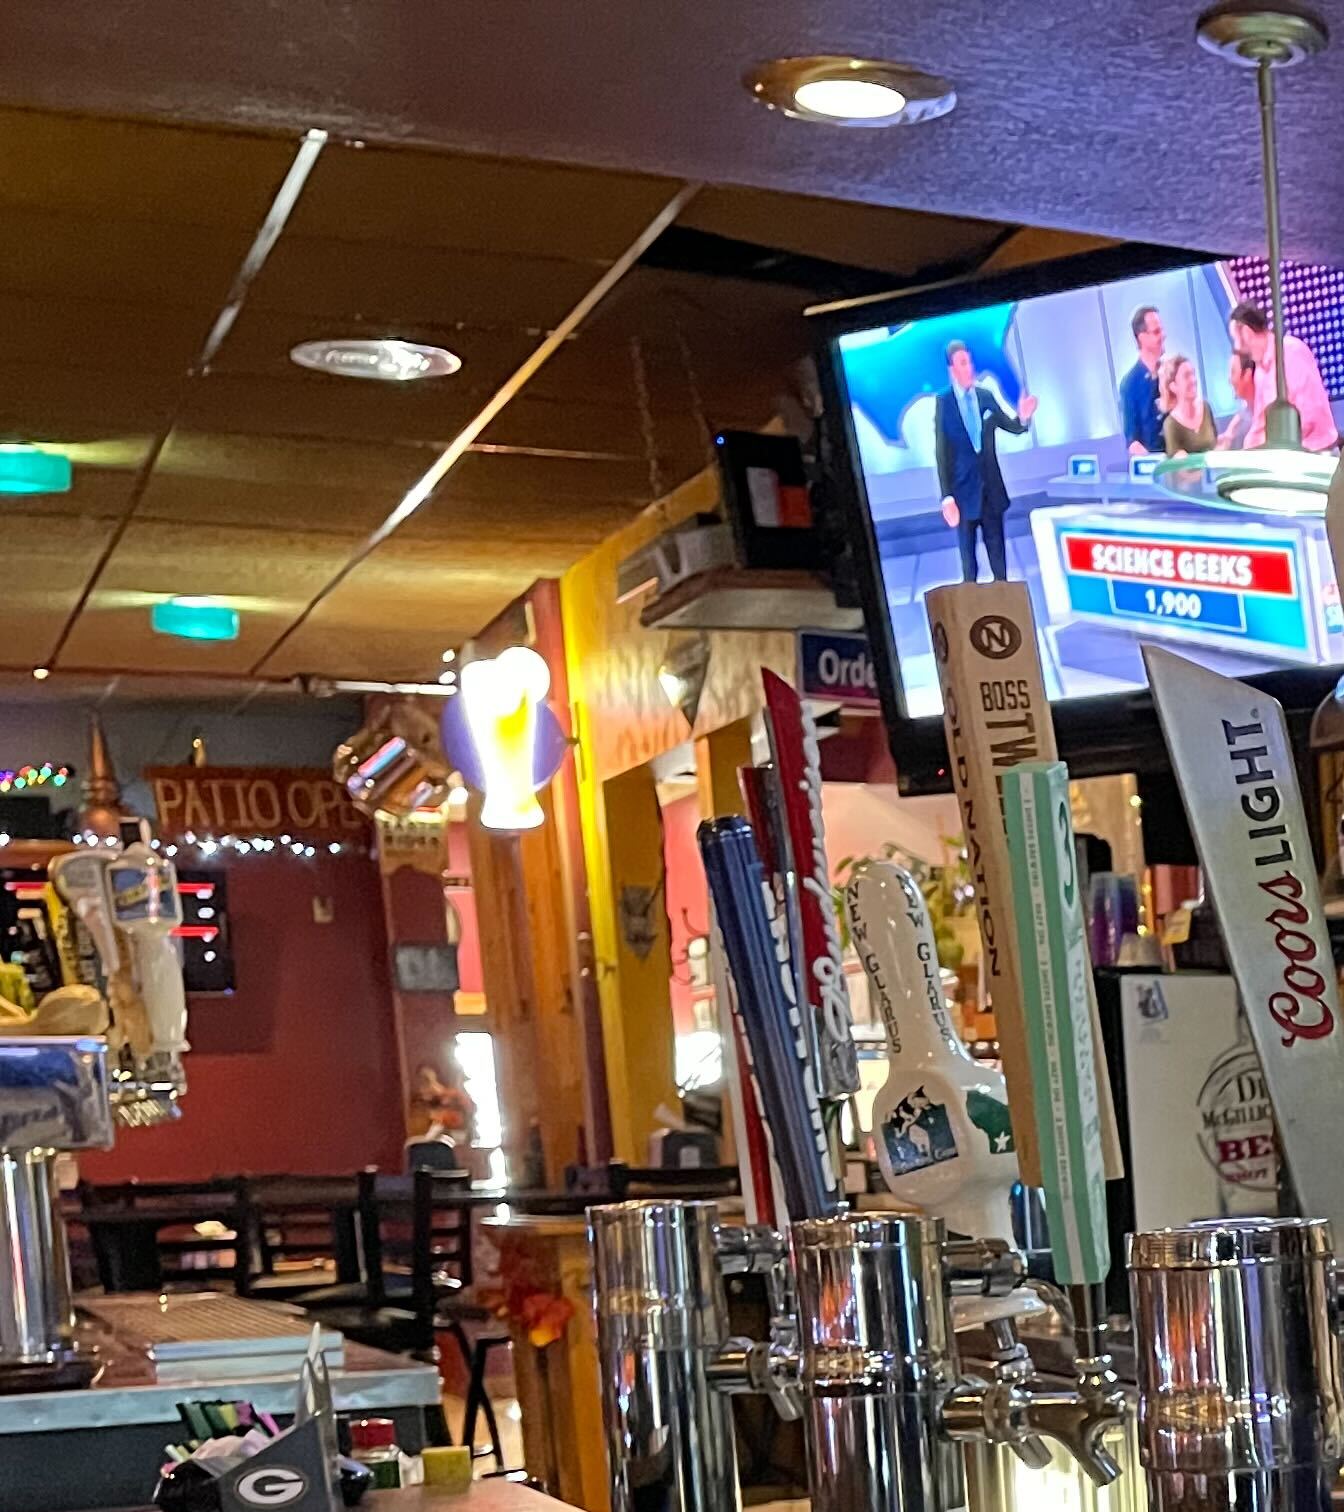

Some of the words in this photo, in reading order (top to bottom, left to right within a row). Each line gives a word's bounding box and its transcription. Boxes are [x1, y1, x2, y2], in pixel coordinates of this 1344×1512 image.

[1090, 543, 1176, 580] SCIENCE
[1176, 551, 1253, 586] GEEKS
[1145, 589, 1203, 619] 1,900
[979, 679, 1031, 712] BOSS
[154, 778, 281, 830] PATIO
[1221, 717, 1294, 867] LIGHT
[963, 799, 1001, 977] NATION
[846, 881, 868, 942] NEW
[865, 953, 902, 1054] GLARUS
[916, 942, 951, 1043] GLARUS
[1256, 869, 1335, 1049] Coors
